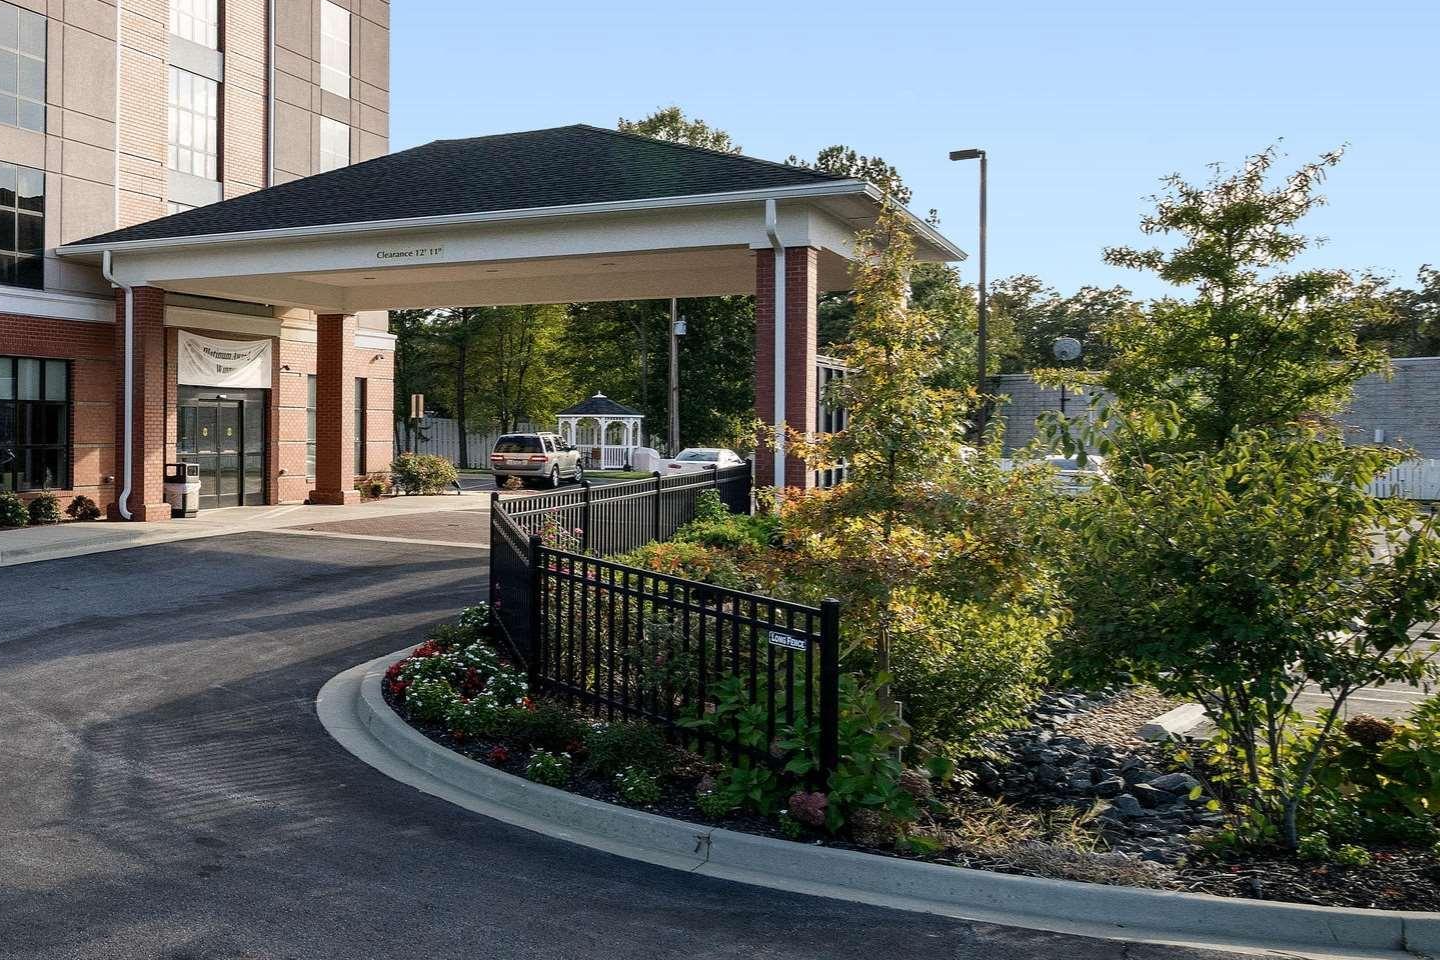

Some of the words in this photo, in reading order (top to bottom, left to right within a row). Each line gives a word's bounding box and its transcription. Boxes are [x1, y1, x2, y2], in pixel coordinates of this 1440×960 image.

[376, 251, 414, 259] Clearance
[771, 633, 787, 645] LONG
[786, 636, 806, 649] FENCE
